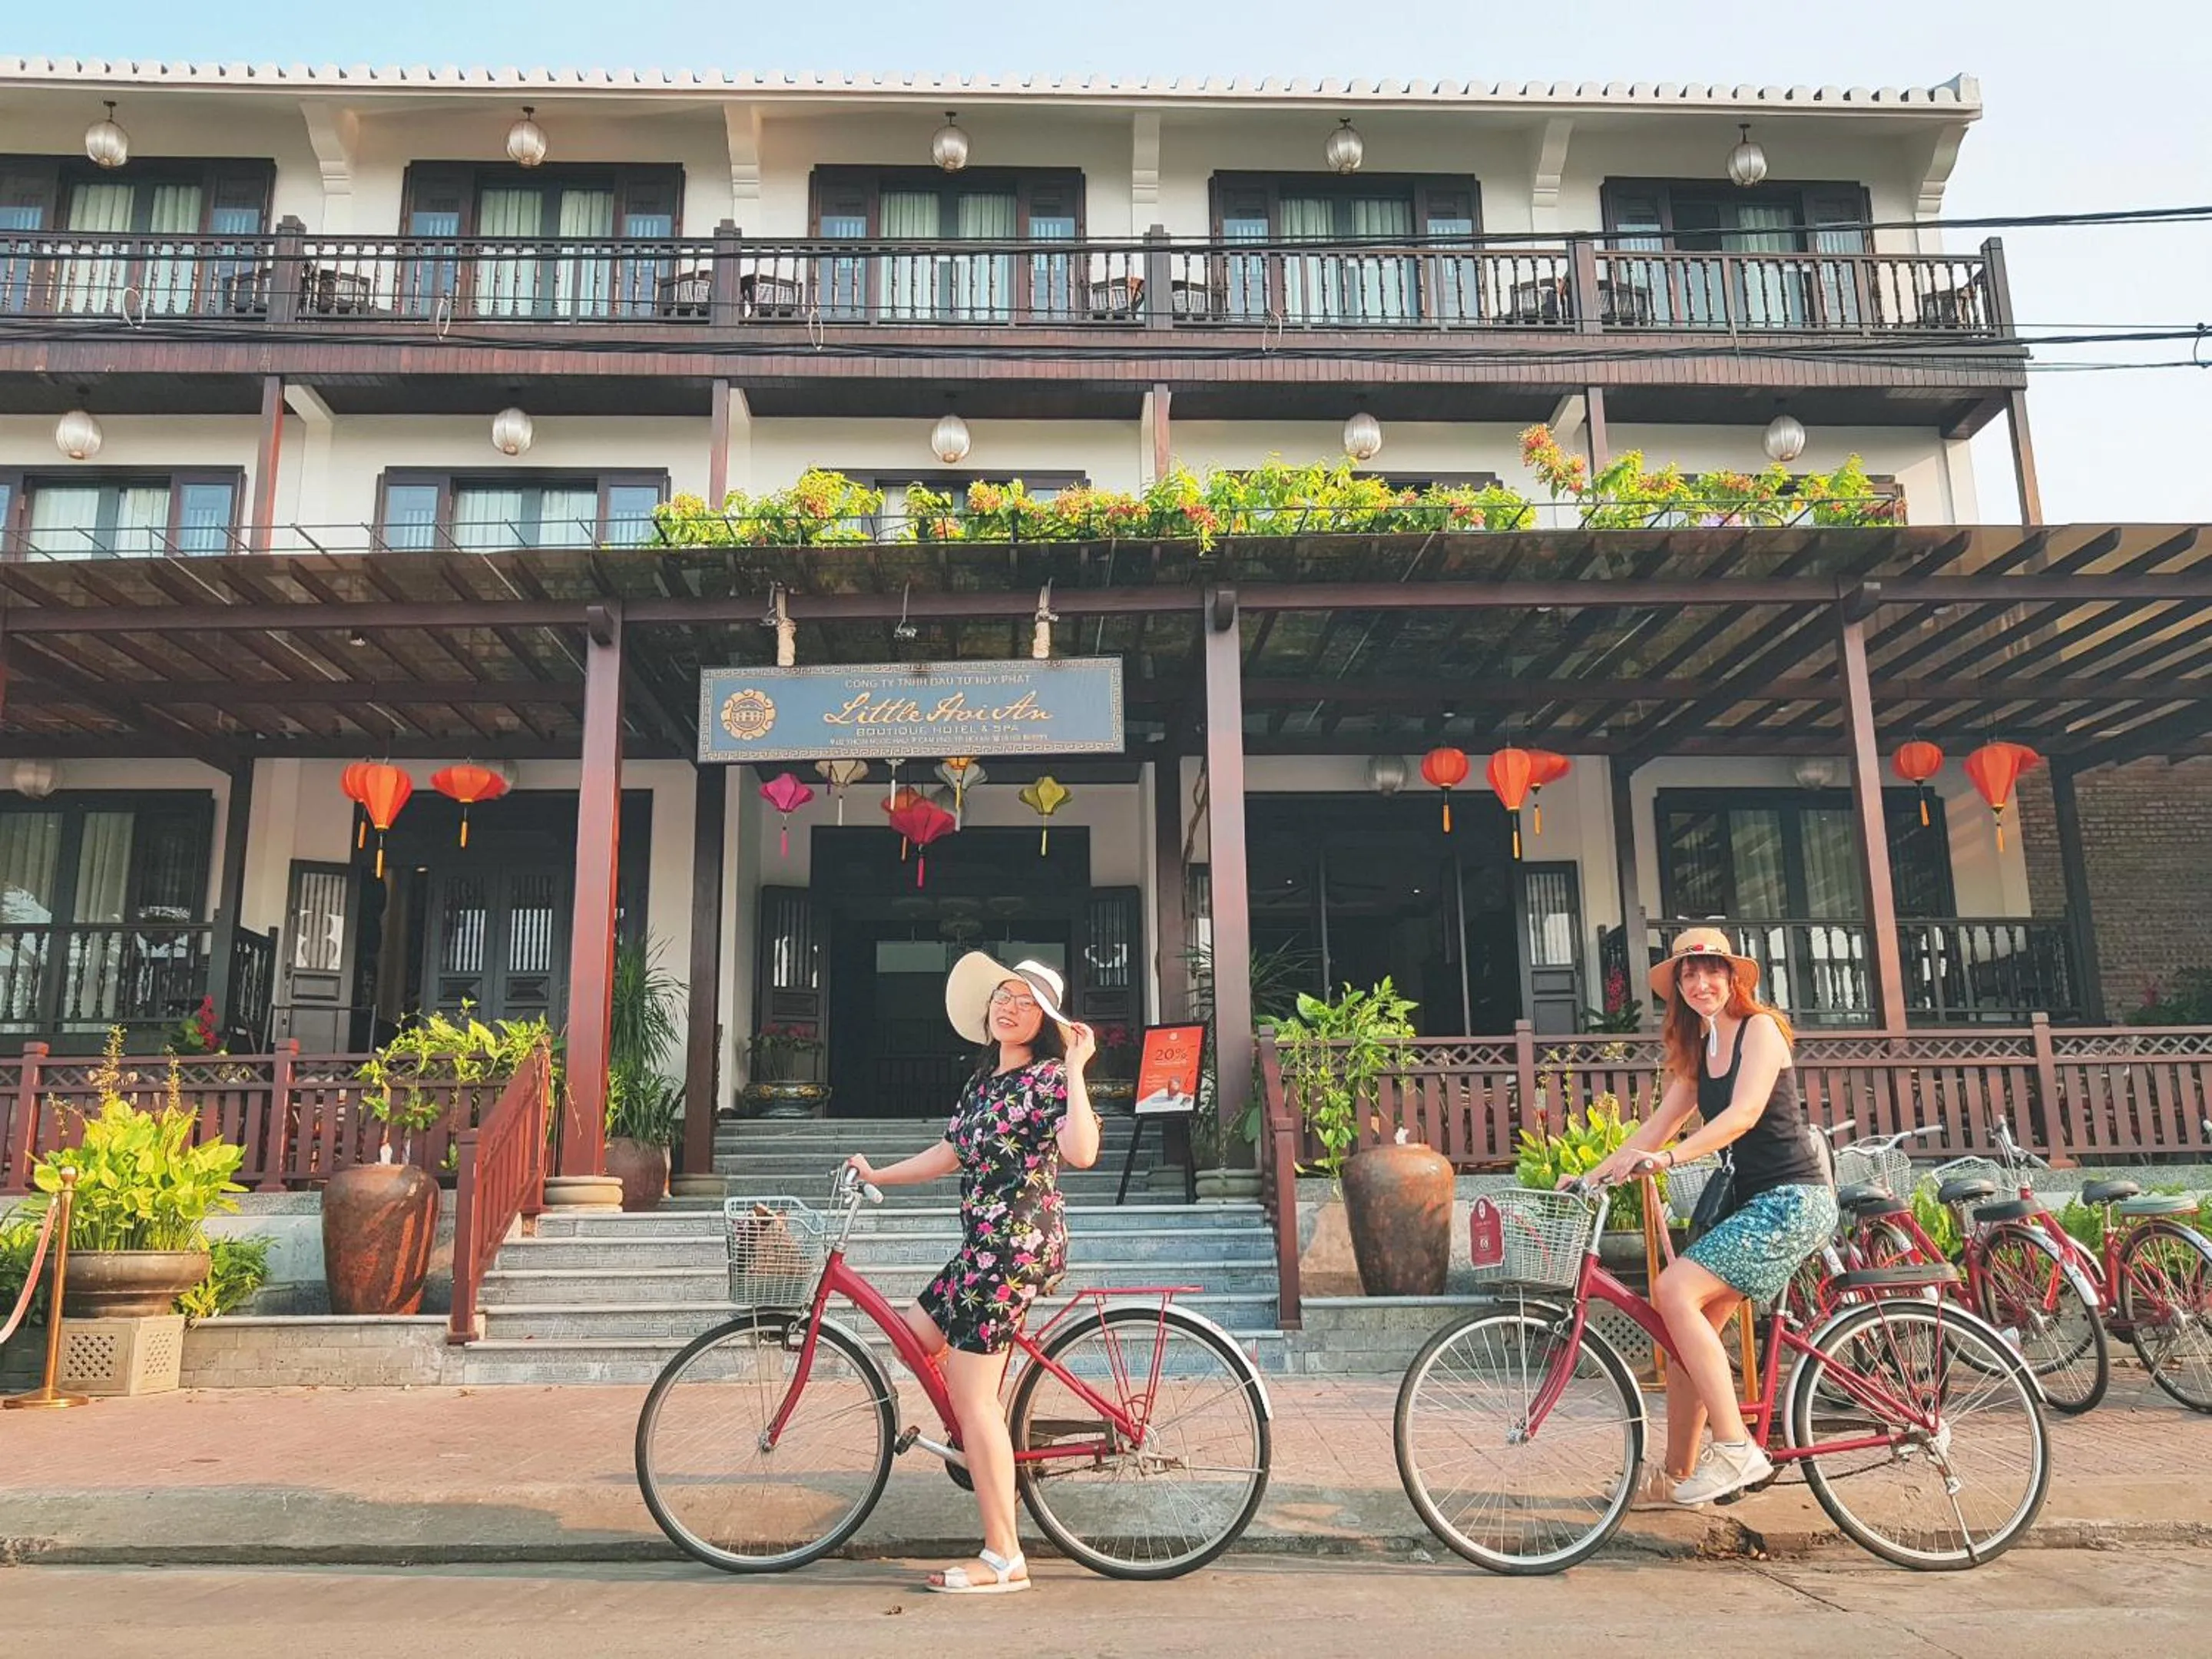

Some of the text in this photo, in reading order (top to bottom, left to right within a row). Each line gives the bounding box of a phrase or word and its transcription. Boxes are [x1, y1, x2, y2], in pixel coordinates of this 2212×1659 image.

[823, 690, 1054, 724] Little Hoi An
[856, 726, 927, 737] BOUTIQUE
[932, 724, 976, 734] HOTEL
[993, 724, 1019, 732] SPA
[1154, 1048, 1188, 1061] 20%
